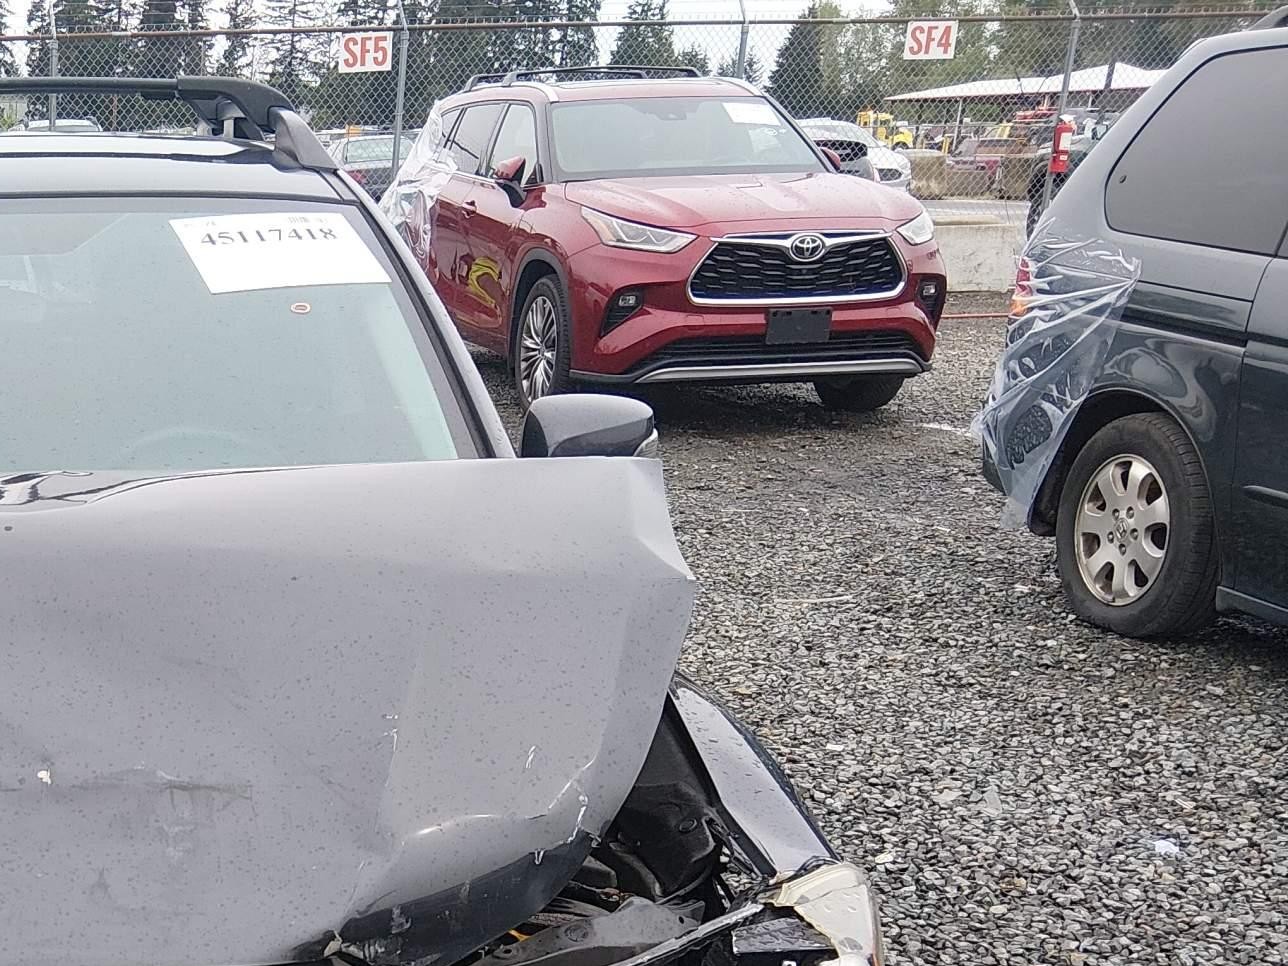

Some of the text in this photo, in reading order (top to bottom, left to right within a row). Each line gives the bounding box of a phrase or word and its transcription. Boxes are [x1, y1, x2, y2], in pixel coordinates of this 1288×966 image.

[343, 35, 388, 68] SF5
[908, 25, 952, 55] SF4
[200, 227, 338, 245] 45117418
